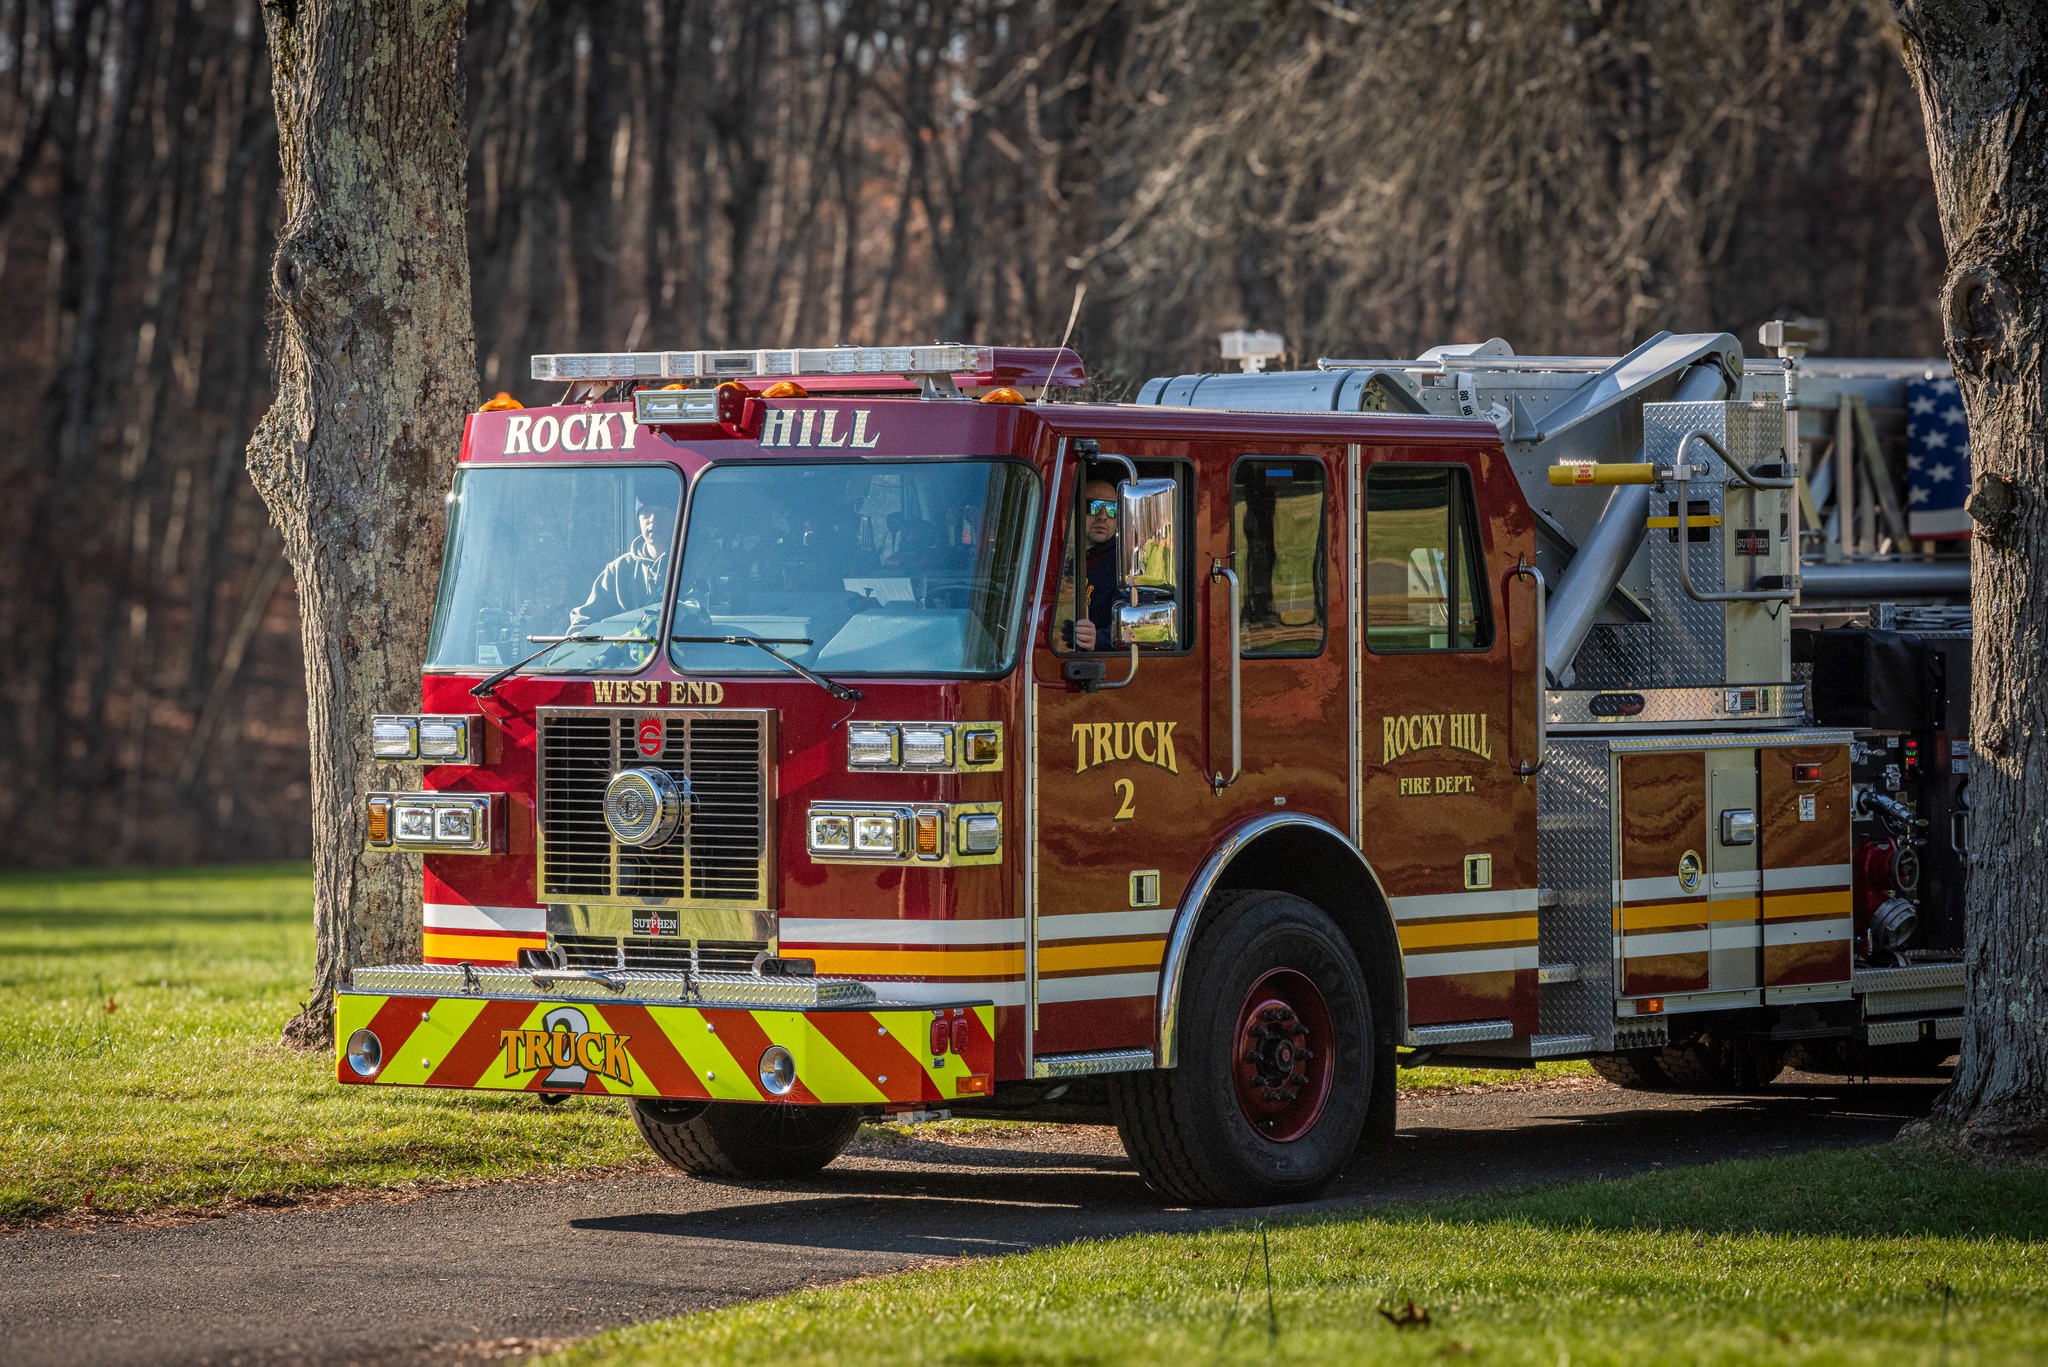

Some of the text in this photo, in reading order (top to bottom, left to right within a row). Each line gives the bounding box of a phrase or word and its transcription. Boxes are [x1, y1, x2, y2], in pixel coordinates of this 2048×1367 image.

[503, 409, 881, 455] ROCKY HILL
[1737, 538, 1769, 548] SUTPHEN
[592, 680, 724, 705] WEST END
[1071, 721, 1179, 776] TRUCK
[1382, 713, 1492, 766] ROCKY HILL
[1113, 778, 1136, 821] 2
[1400, 775, 1475, 795] FIRE DEPT.
[633, 918, 677, 929] SUTPHEN
[499, 1028, 633, 1087] TRUCK
[541, 1006, 590, 1090] 2
